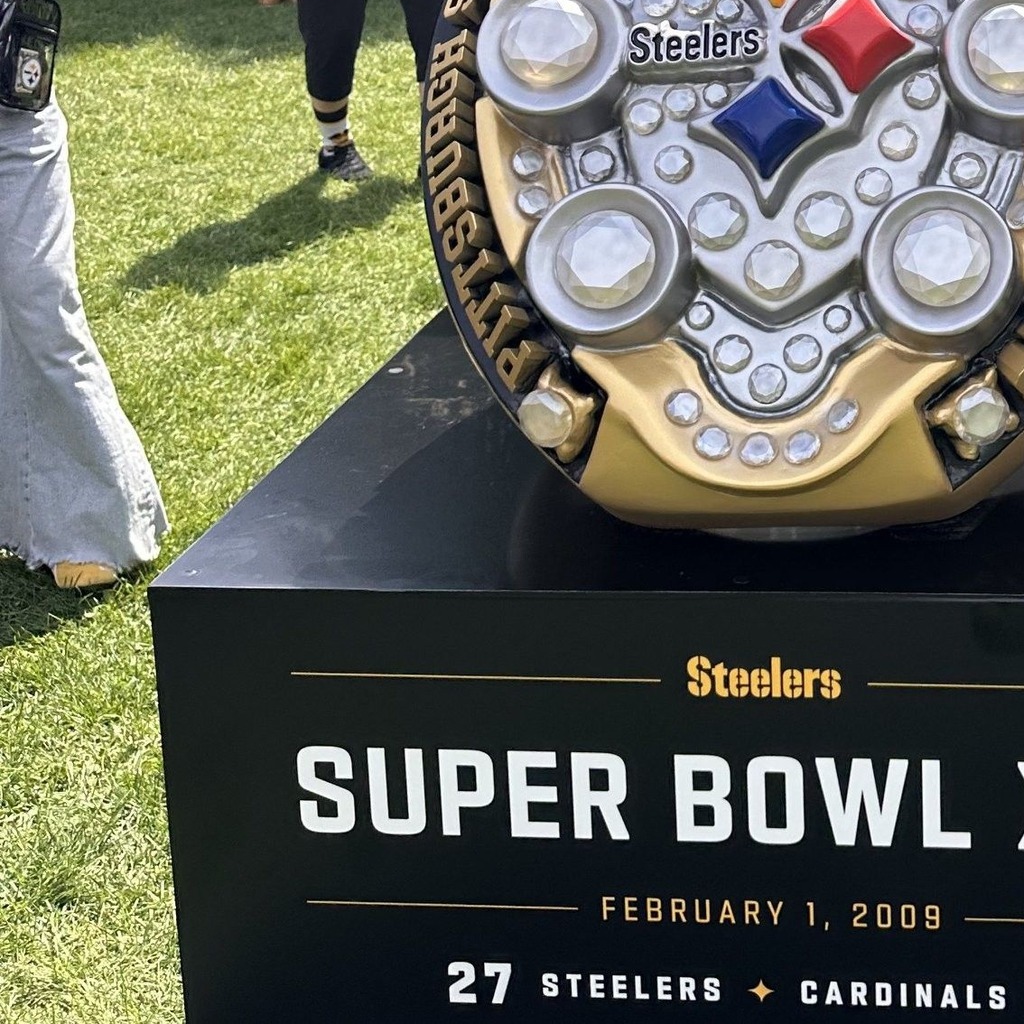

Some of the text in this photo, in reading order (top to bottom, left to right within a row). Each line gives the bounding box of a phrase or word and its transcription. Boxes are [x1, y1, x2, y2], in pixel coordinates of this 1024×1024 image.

[629, 24, 760, 64] Steelers
[425, 28, 540, 392] PITTSBURGH
[686, 655, 842, 699] Steelers
[297, 745, 632, 841] SUPER
[673, 753, 973, 850] BOWL
[600, 895, 943, 931] FEBRUARY 1, 2009
[447, 960, 513, 1006] 27
[541, 972, 724, 1003] STEELERS
[799, 979, 1007, 1012] CARDINALS
